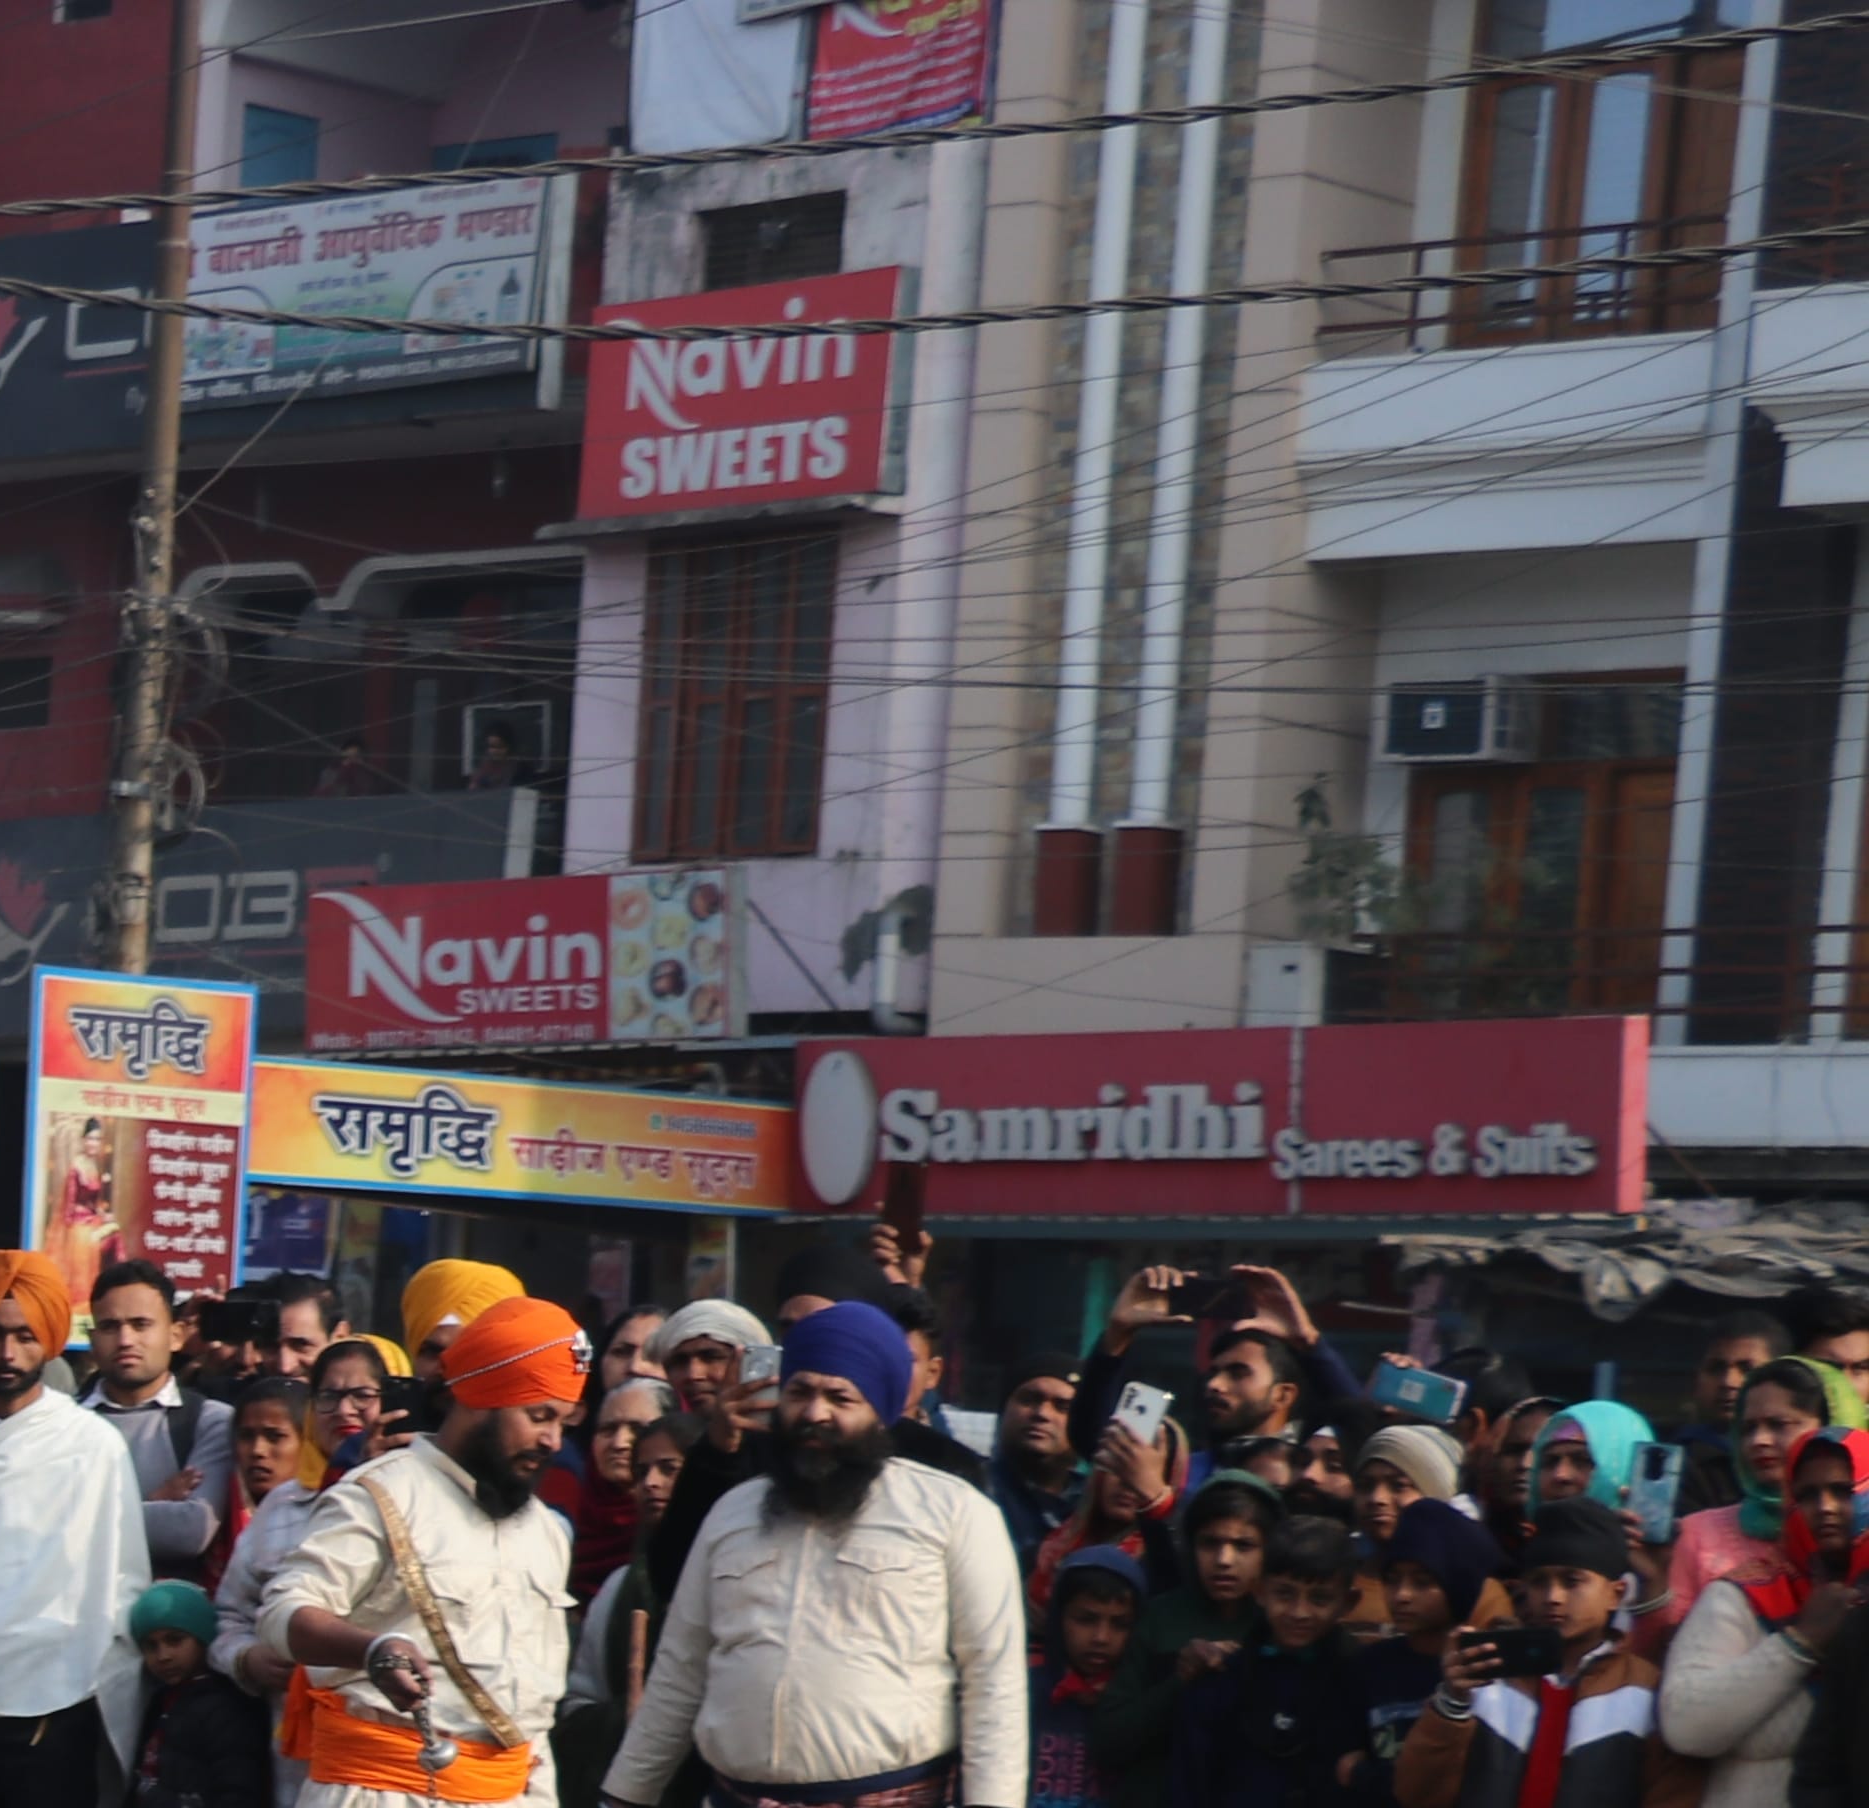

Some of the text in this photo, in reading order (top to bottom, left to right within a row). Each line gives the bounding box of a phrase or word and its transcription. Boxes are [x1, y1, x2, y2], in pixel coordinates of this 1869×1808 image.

[208, 226, 304, 275] बालाजी
[598, 295, 857, 430] Navin
[620, 415, 849, 499] SWEETS
[310, 891, 603, 1023] Navin
[456, 983, 599, 1015] SWEETS
[68, 997, 212, 1080] समृद्धि
[312, 1082, 757, 1196] समृद्धि साड़ीज एण्ड सूट्स
[878, 1081, 1597, 1180] Samridhi Sarees & Suits
